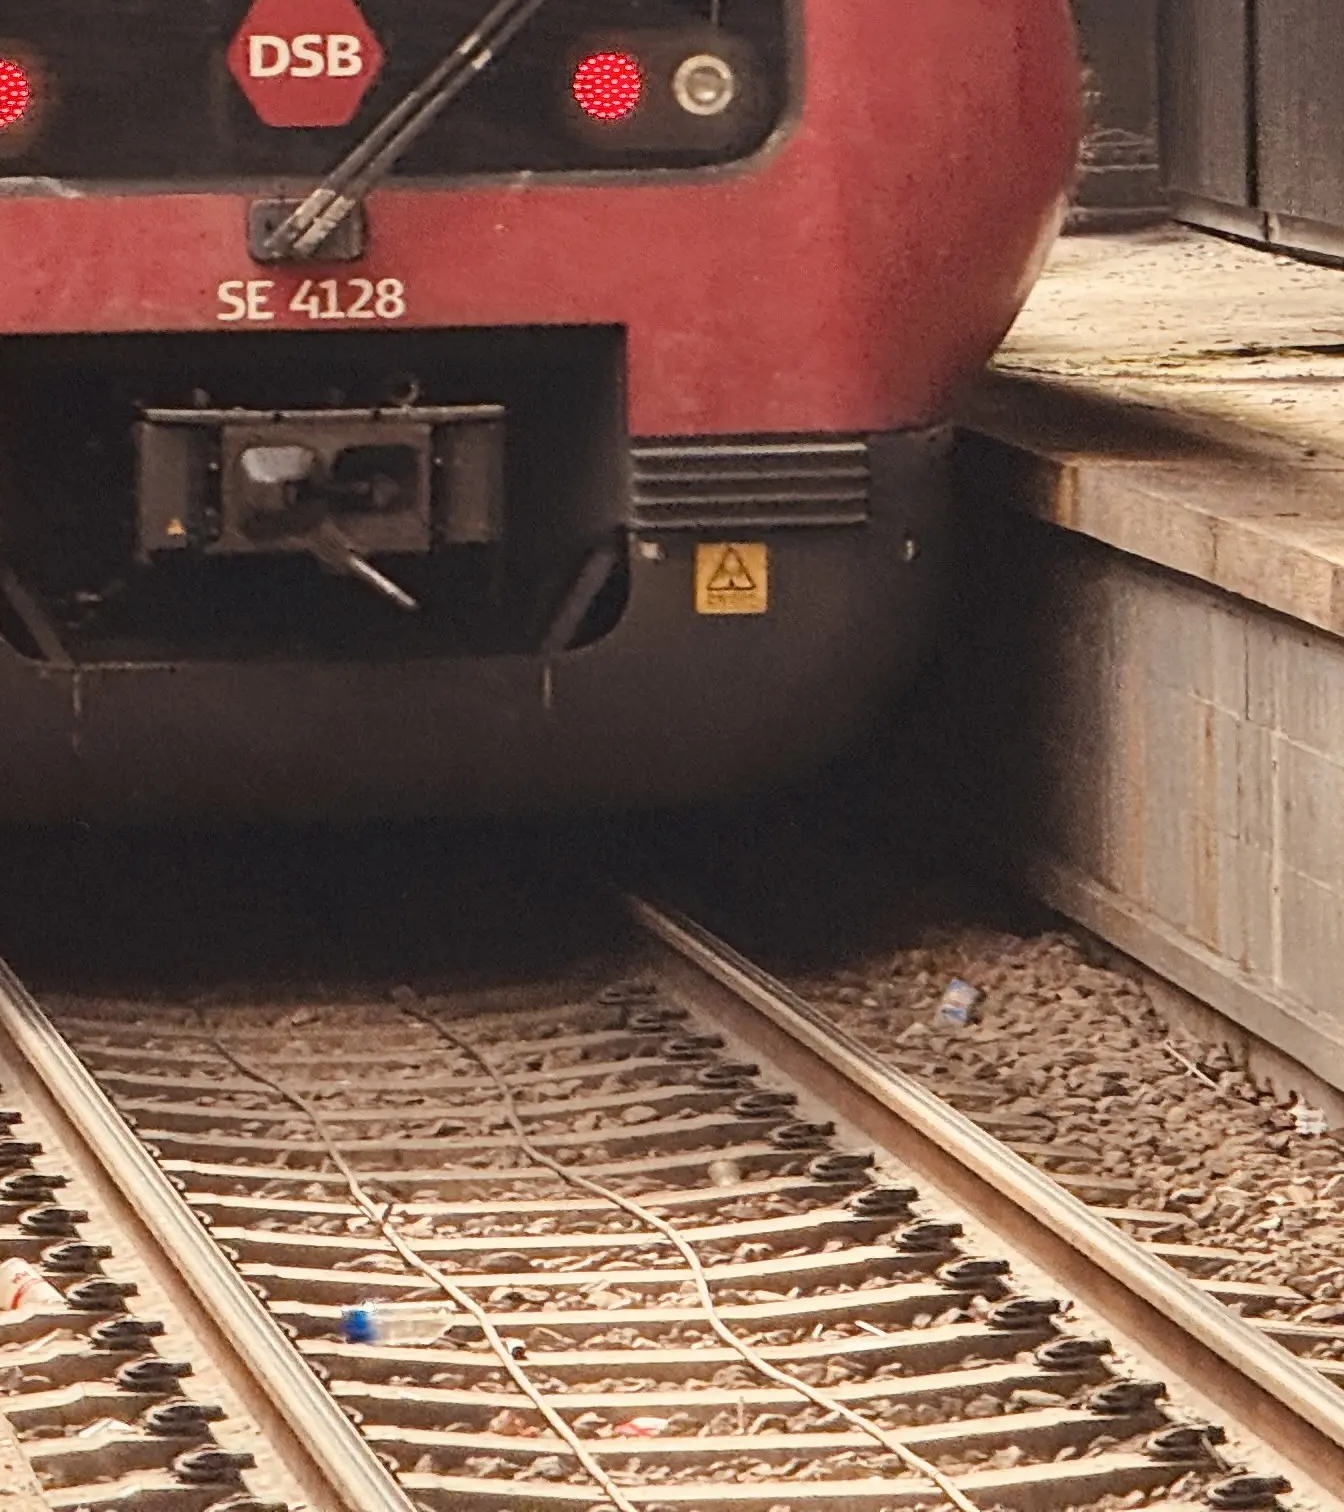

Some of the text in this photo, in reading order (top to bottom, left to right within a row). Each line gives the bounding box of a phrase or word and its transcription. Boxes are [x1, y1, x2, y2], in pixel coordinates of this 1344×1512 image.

[249, 34, 362, 78] DSB
[217, 278, 406, 321] SE 4128
